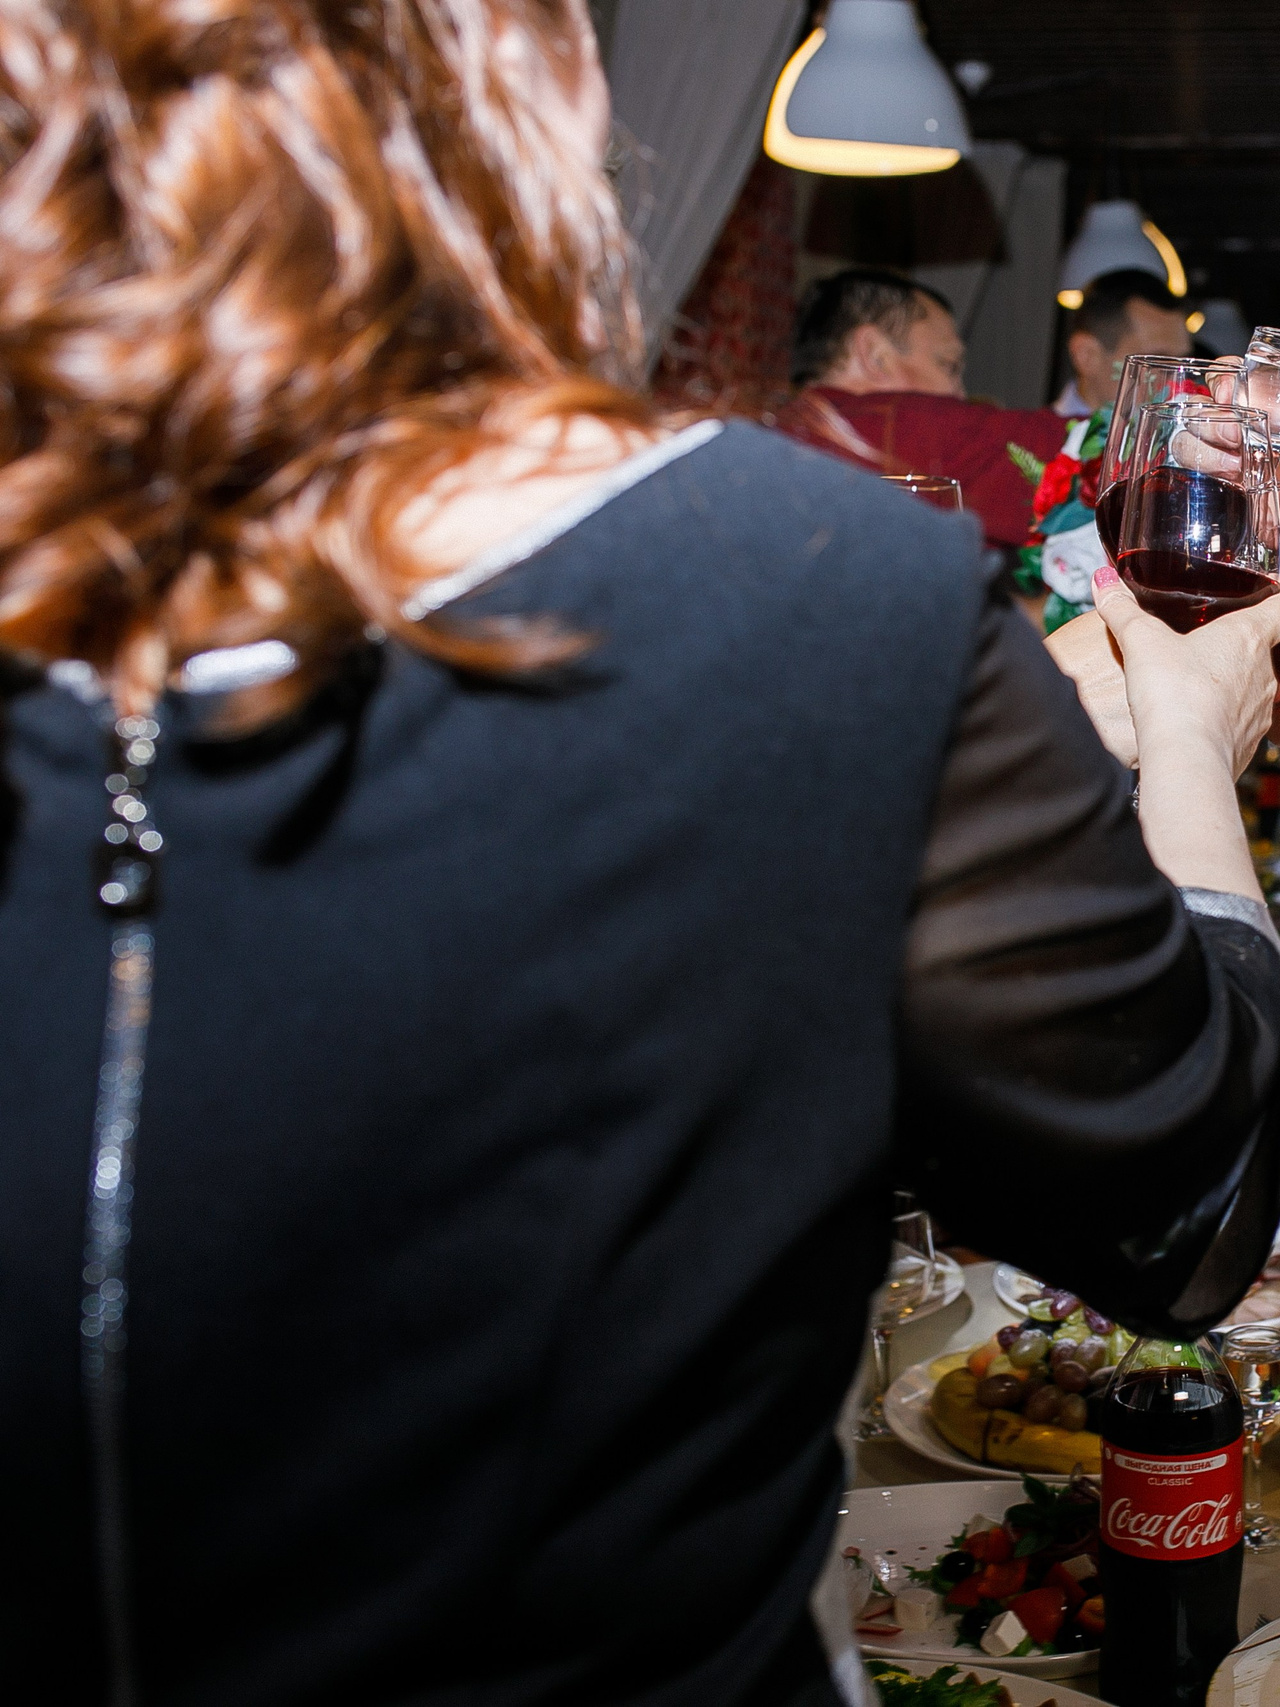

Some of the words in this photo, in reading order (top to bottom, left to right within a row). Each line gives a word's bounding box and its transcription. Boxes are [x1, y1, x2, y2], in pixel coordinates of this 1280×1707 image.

[1124, 1459, 1182, 1473] ВЫГОДНАЯ
[1148, 1477, 1194, 1486] CLASSIC
[1107, 1492, 1233, 1549] Coca-Cola
